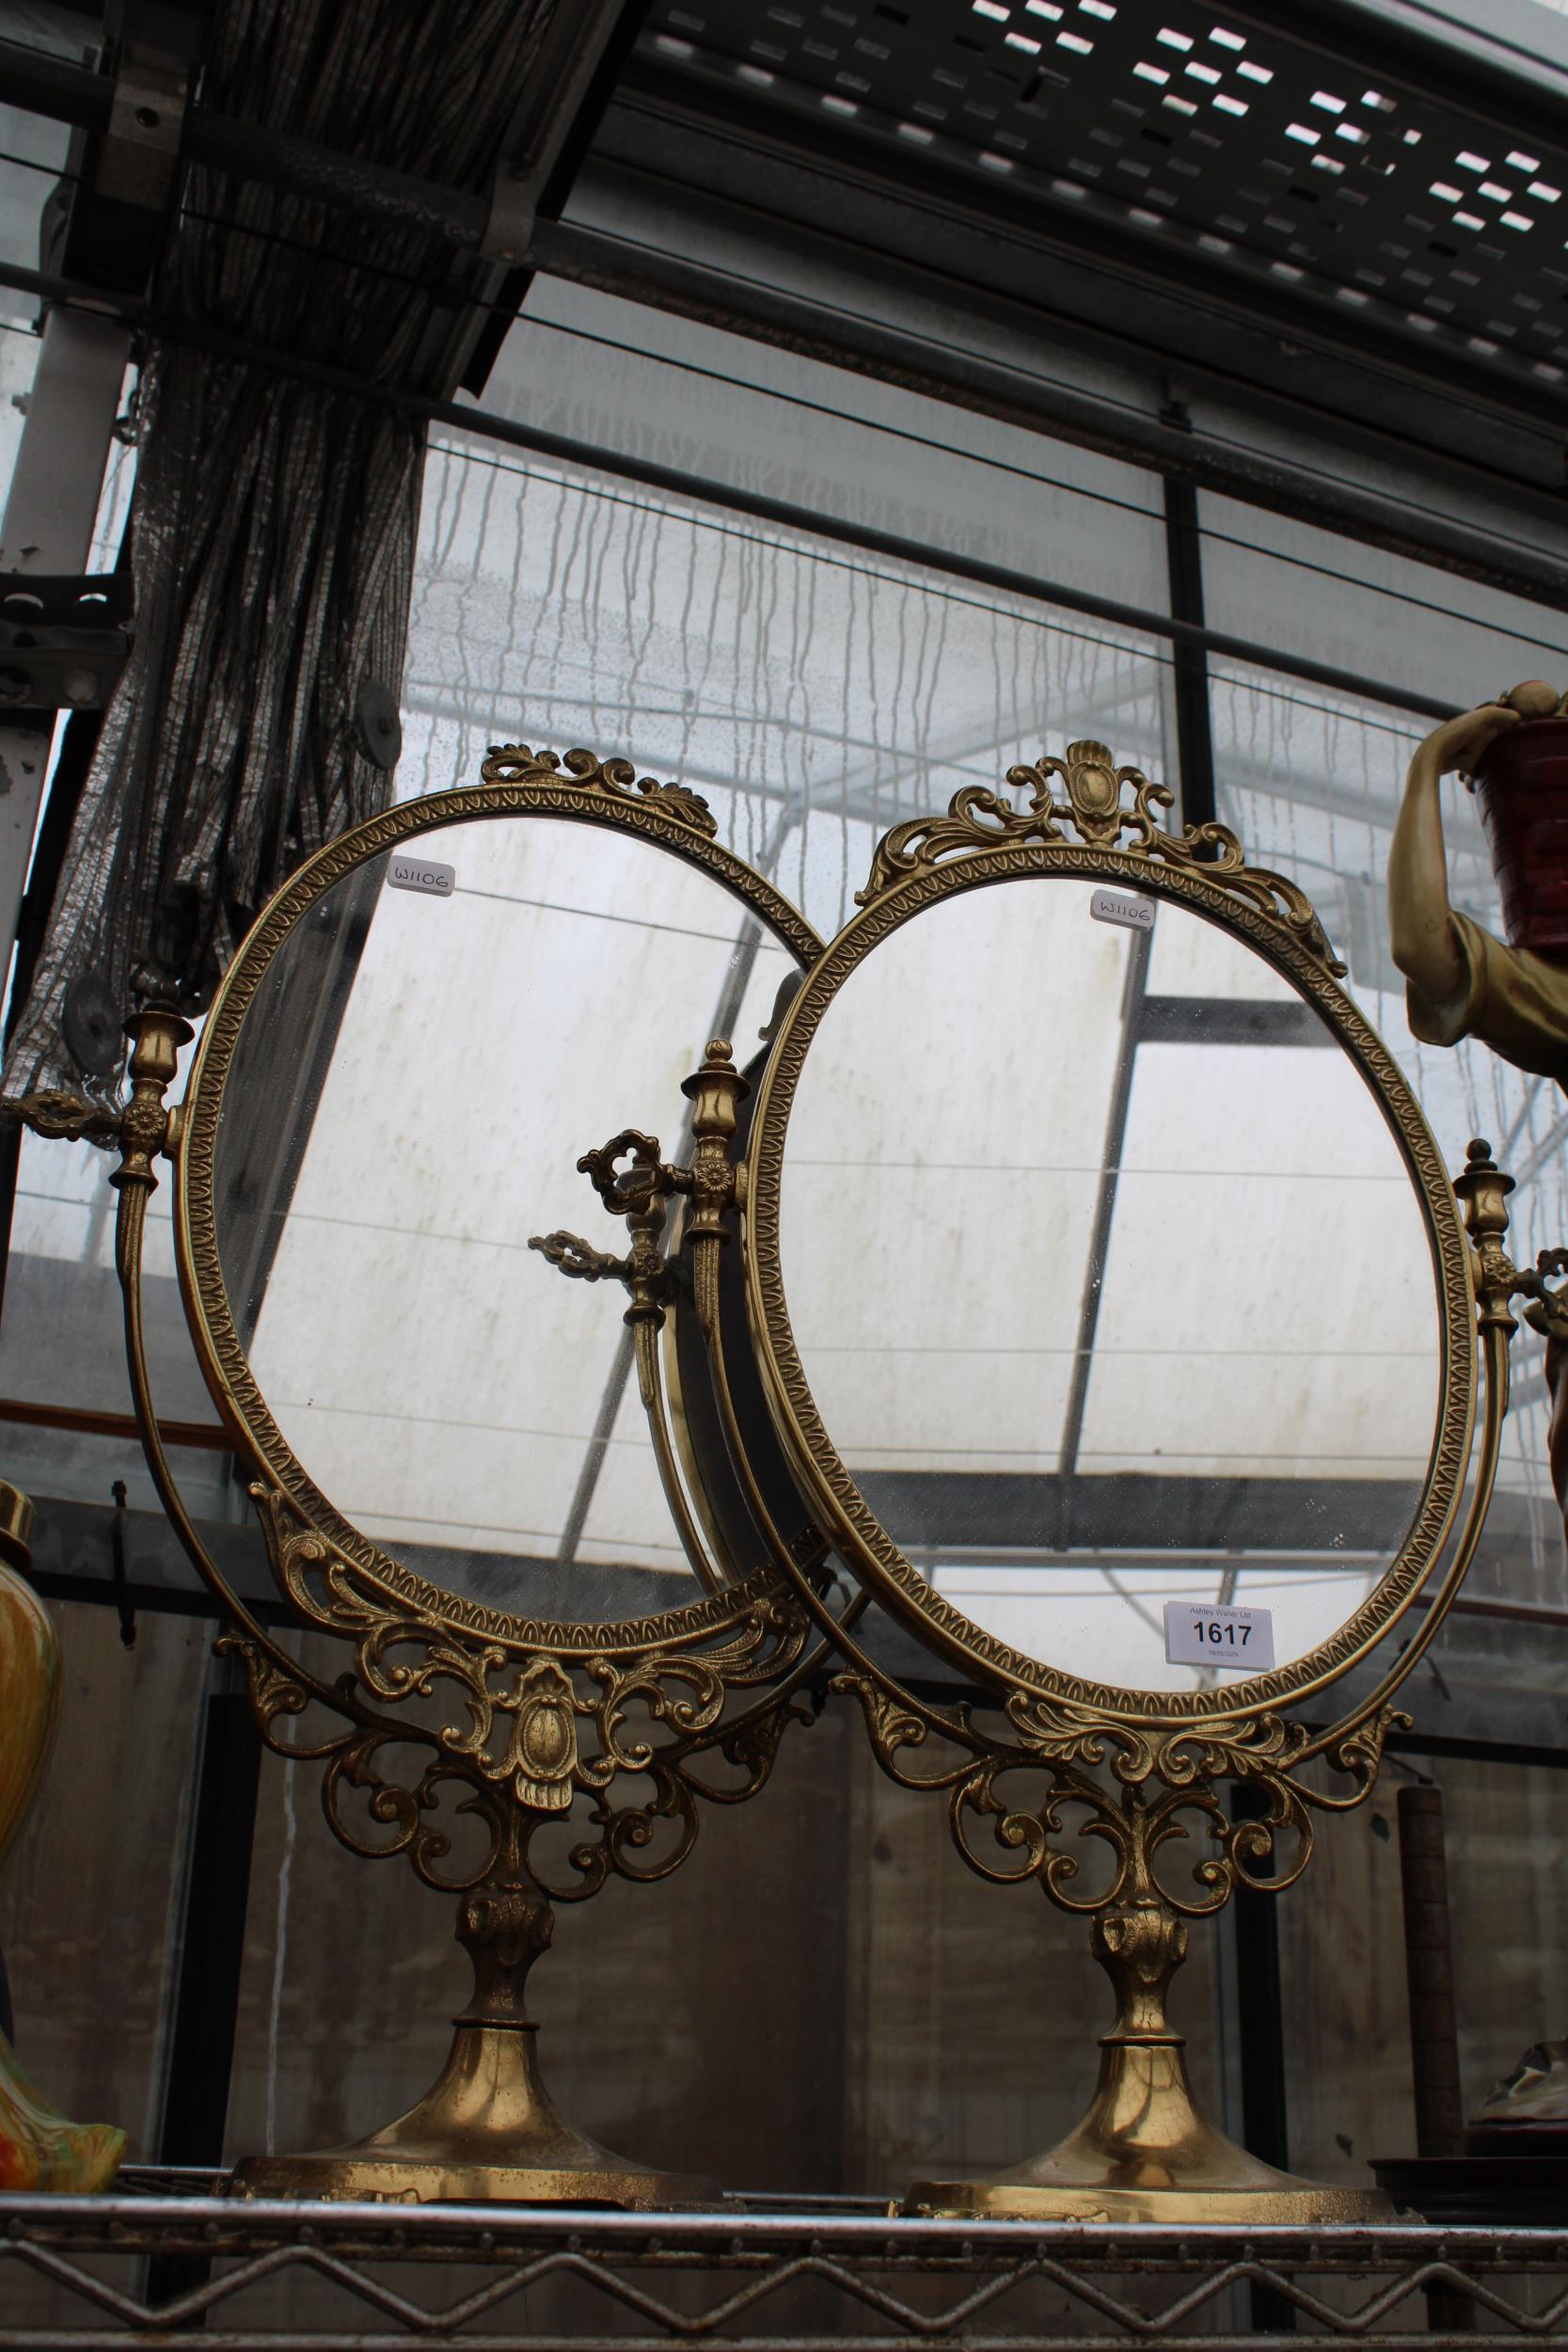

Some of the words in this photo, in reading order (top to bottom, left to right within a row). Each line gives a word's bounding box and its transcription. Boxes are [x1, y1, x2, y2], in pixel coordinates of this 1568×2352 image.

[1101, 901, 1150, 920] W1106
[1190, 1606, 1213, 1616] Ashley
[1215, 1609, 1238, 1618] Waller
[1240, 1611, 1251, 1619] Ltd
[1194, 1621, 1252, 1645] 1617
